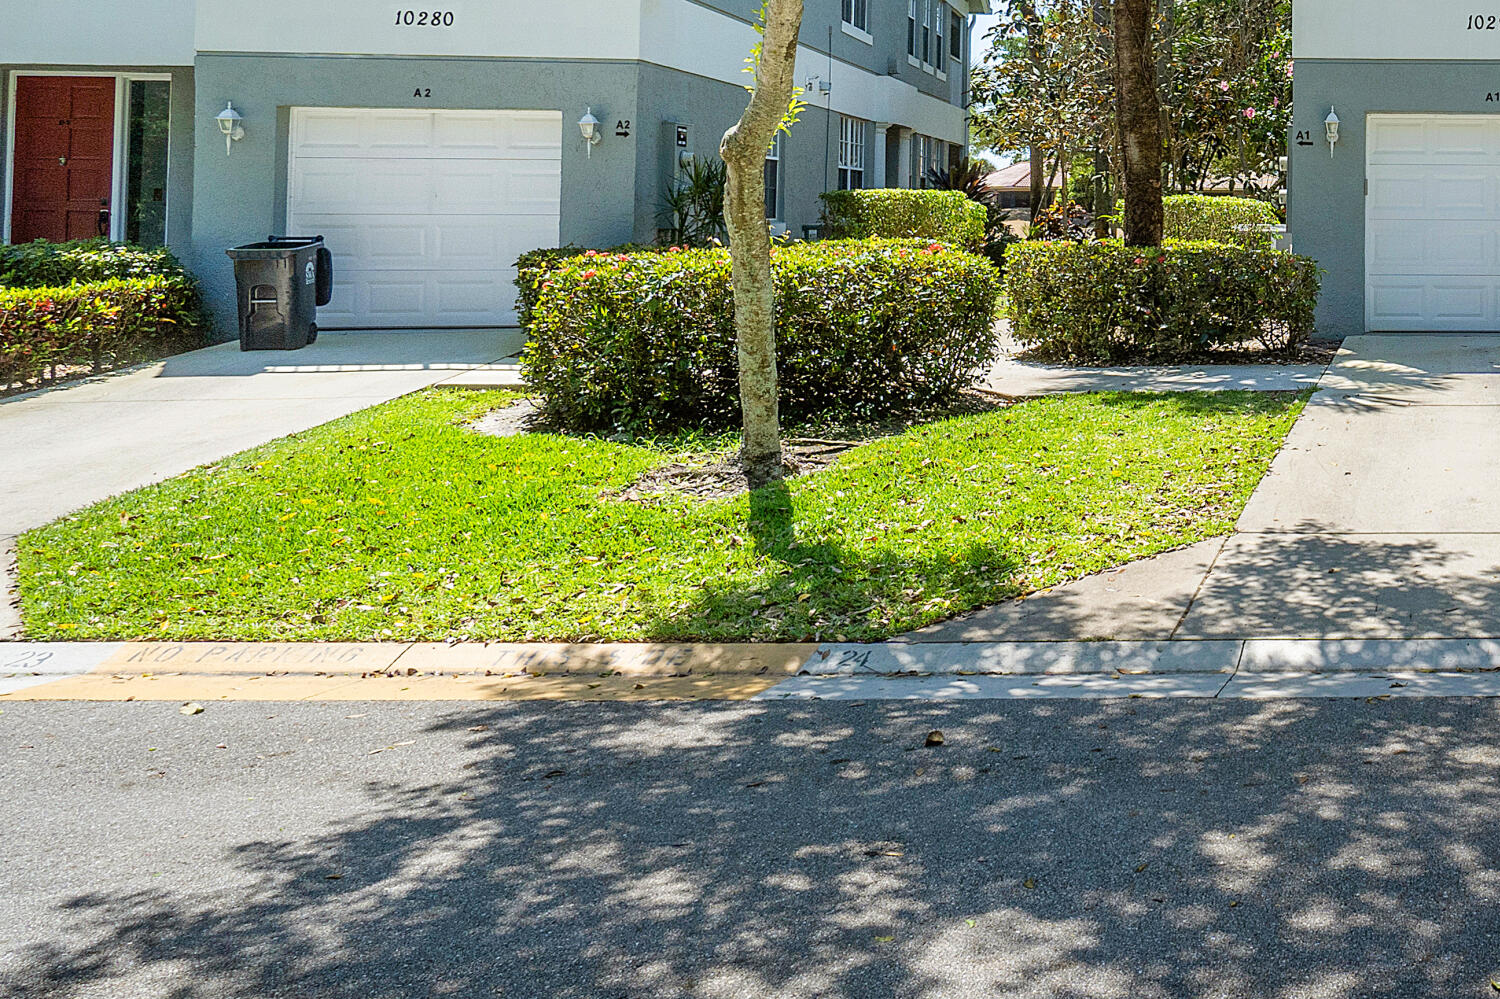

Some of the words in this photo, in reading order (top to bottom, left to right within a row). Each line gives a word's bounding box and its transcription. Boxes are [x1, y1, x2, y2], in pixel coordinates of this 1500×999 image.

[394, 10, 454, 27] 10280
[1485, 92, 1500, 102] A1
[615, 119, 630, 130] A2
[1295, 130, 1310, 140] A1
[3, 650, 54, 668] 23
[126, 645, 184, 663] NO
[196, 645, 366, 664] PARKING
[492, 649, 571, 666] THIS
[601, 648, 694, 666] SIDE
[837, 650, 873, 667] 24
